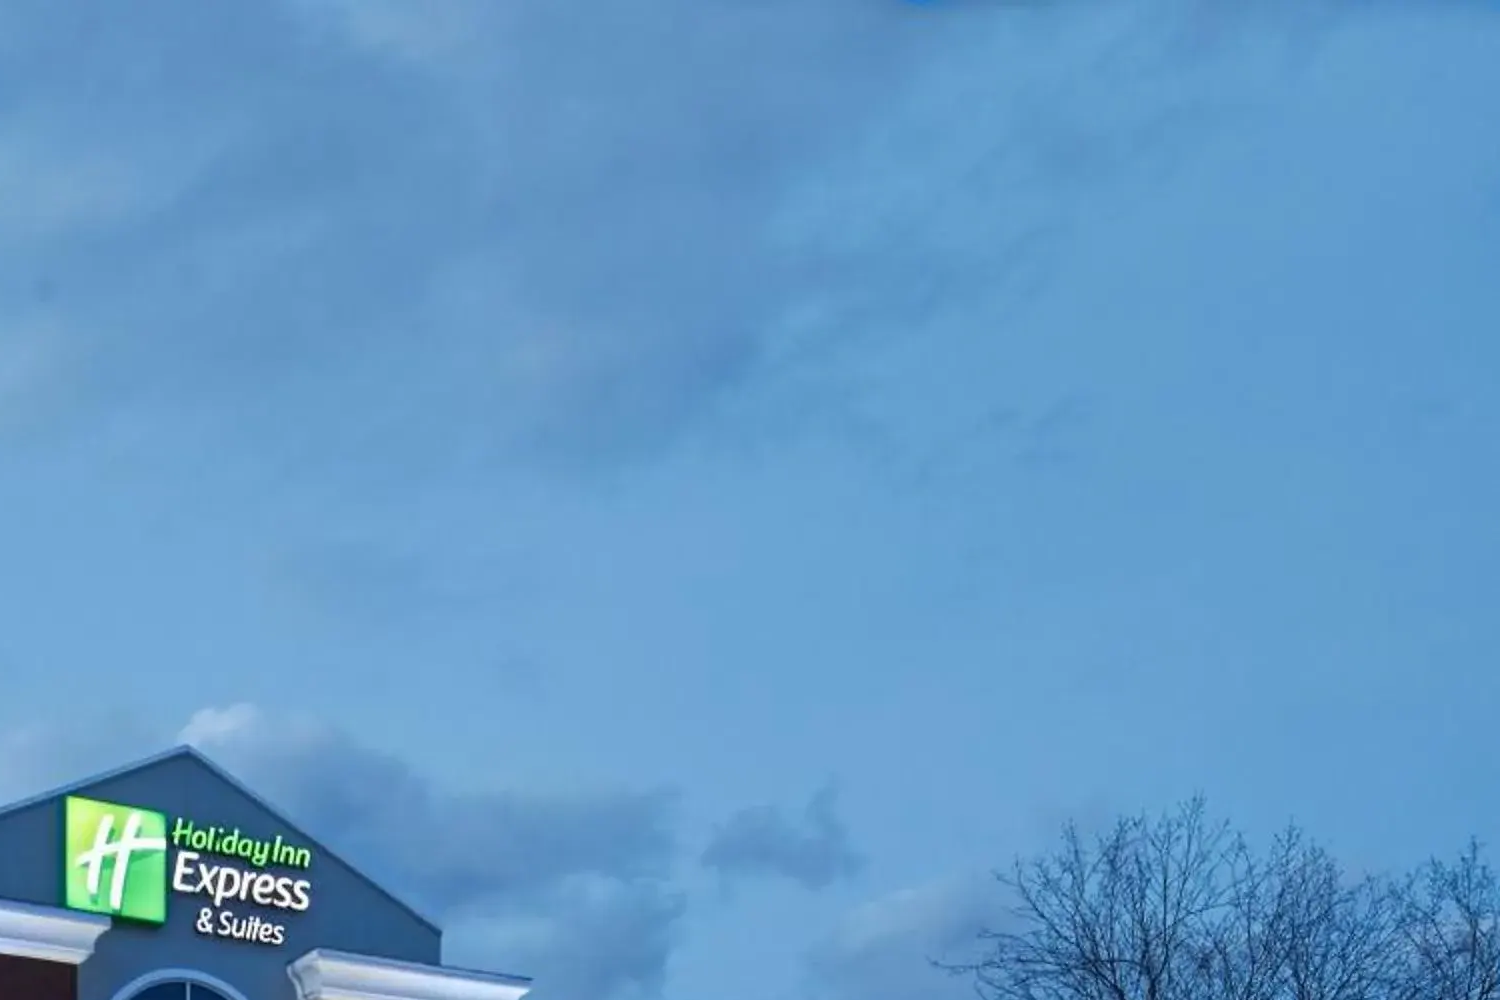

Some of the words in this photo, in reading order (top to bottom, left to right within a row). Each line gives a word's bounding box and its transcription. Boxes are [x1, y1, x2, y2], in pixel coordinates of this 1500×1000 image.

[172, 817, 271, 867] Holiday
[272, 835, 311, 868] Inn
[173, 851, 311, 912] Express
[196, 907, 214, 934] &
[217, 910, 285, 945] Suites
